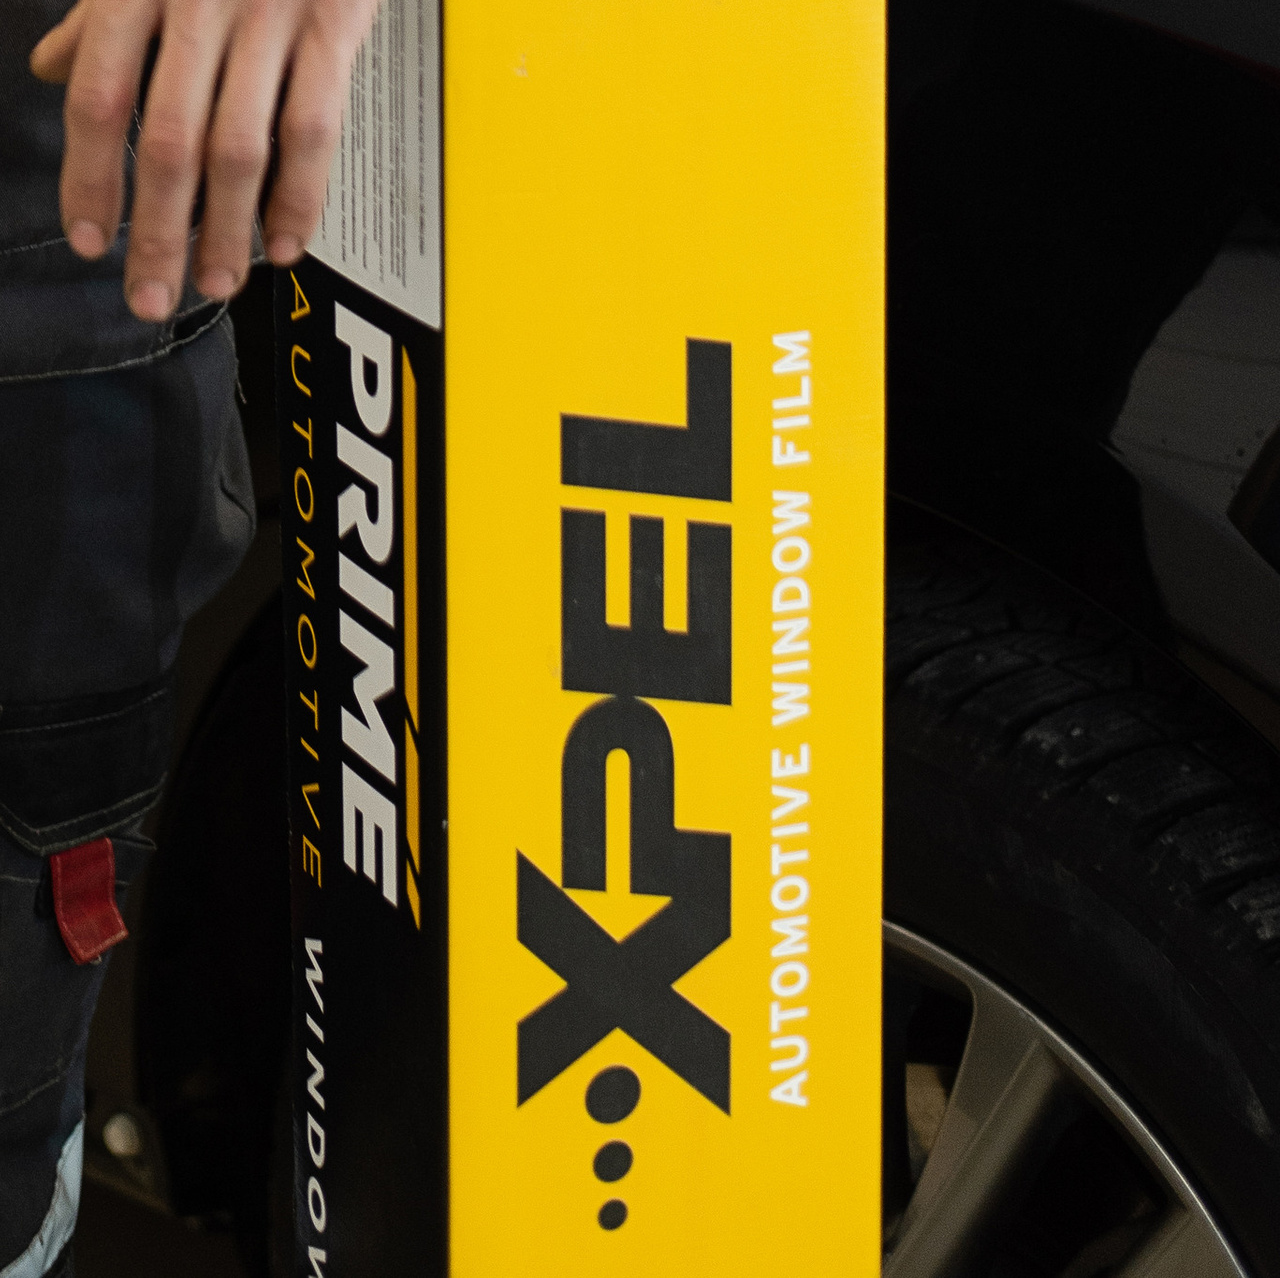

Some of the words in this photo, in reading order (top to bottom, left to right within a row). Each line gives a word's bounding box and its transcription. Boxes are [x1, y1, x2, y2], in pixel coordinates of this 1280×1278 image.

[288, 269, 323, 889] AUTOMOTIVE
[333, 299, 399, 908] PRIME
[770, 328, 813, 468] FILM
[770, 488, 813, 728] WINDOW
[516, 338, 733, 1116] XPEL
[768, 741, 811, 1108] AUTOMOTIVE
